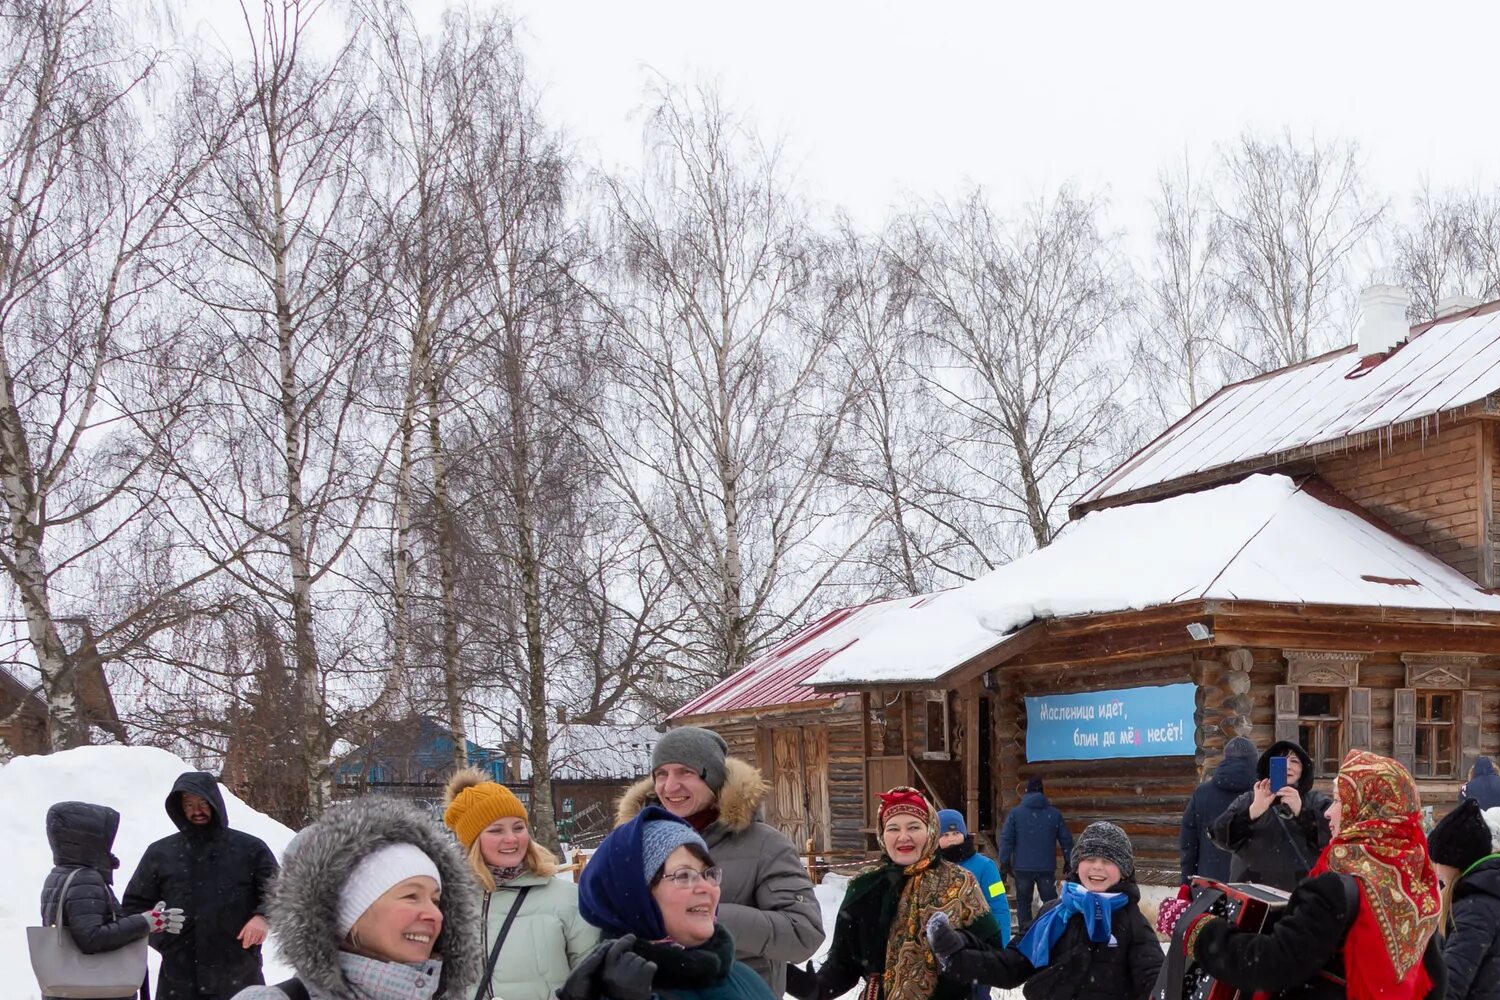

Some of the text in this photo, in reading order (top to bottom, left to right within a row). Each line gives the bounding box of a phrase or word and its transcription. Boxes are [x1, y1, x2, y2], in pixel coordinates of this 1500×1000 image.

[1040, 703, 1095, 720] Масленица
[1073, 727, 1099, 747] блин
[1103, 731, 1116, 747] да
[1147, 719, 1183, 743] несёт!
